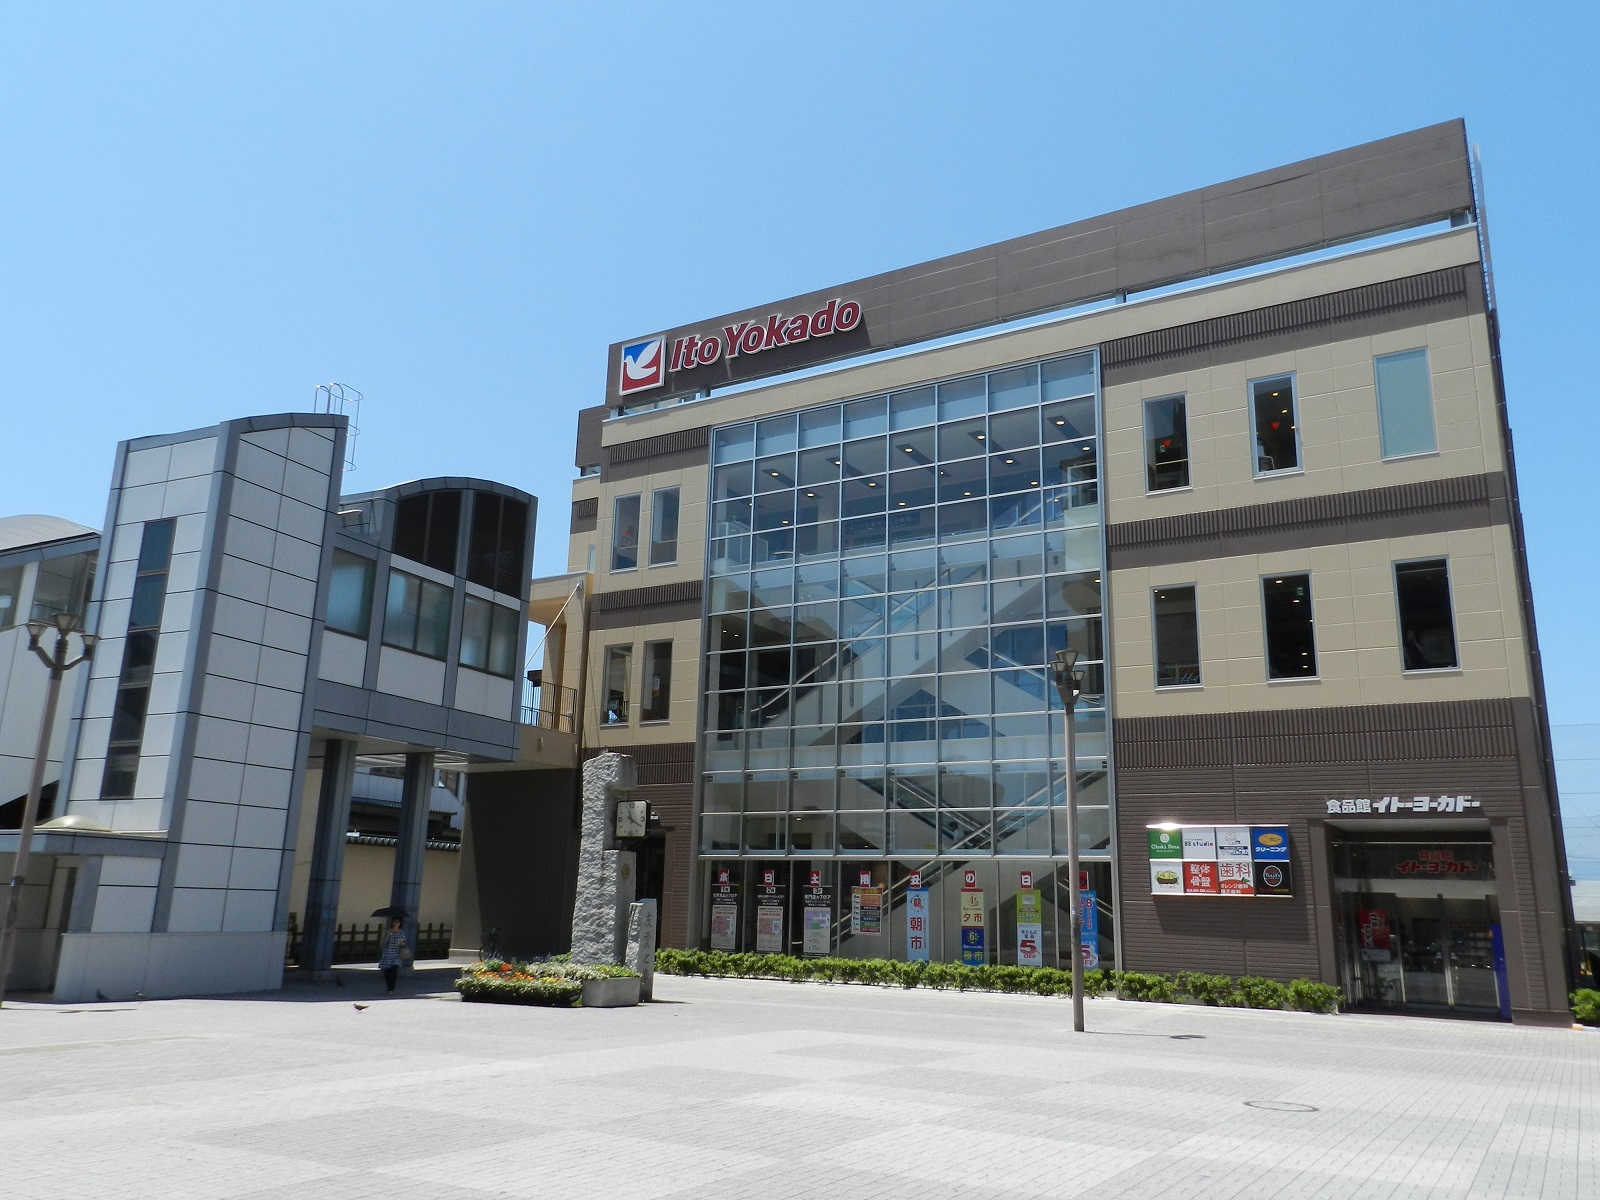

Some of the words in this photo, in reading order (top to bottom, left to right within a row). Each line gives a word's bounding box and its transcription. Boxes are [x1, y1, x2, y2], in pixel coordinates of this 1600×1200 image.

[669, 334, 722, 373] Ito
[722, 298, 862, 359] Yokado
[1326, 795, 1481, 814] 食品館イトーヨーカドー
[1192, 839, 1214, 847] studio
[1418, 850, 1453, 861] 食品館
[1190, 863, 1211, 875] 整体
[1220, 863, 1251, 878] 歯科
[1396, 861, 1479, 874] イトーヨーカドー
[764, 873, 773, 883] 日
[810, 873, 820, 884] 土
[965, 873, 975, 883] の
[1021, 874, 1031, 885] 日
[1190, 876, 1211, 887] 骨盤
[963, 913, 983, 923] 夕市
[910, 916, 922, 950] 朝市
